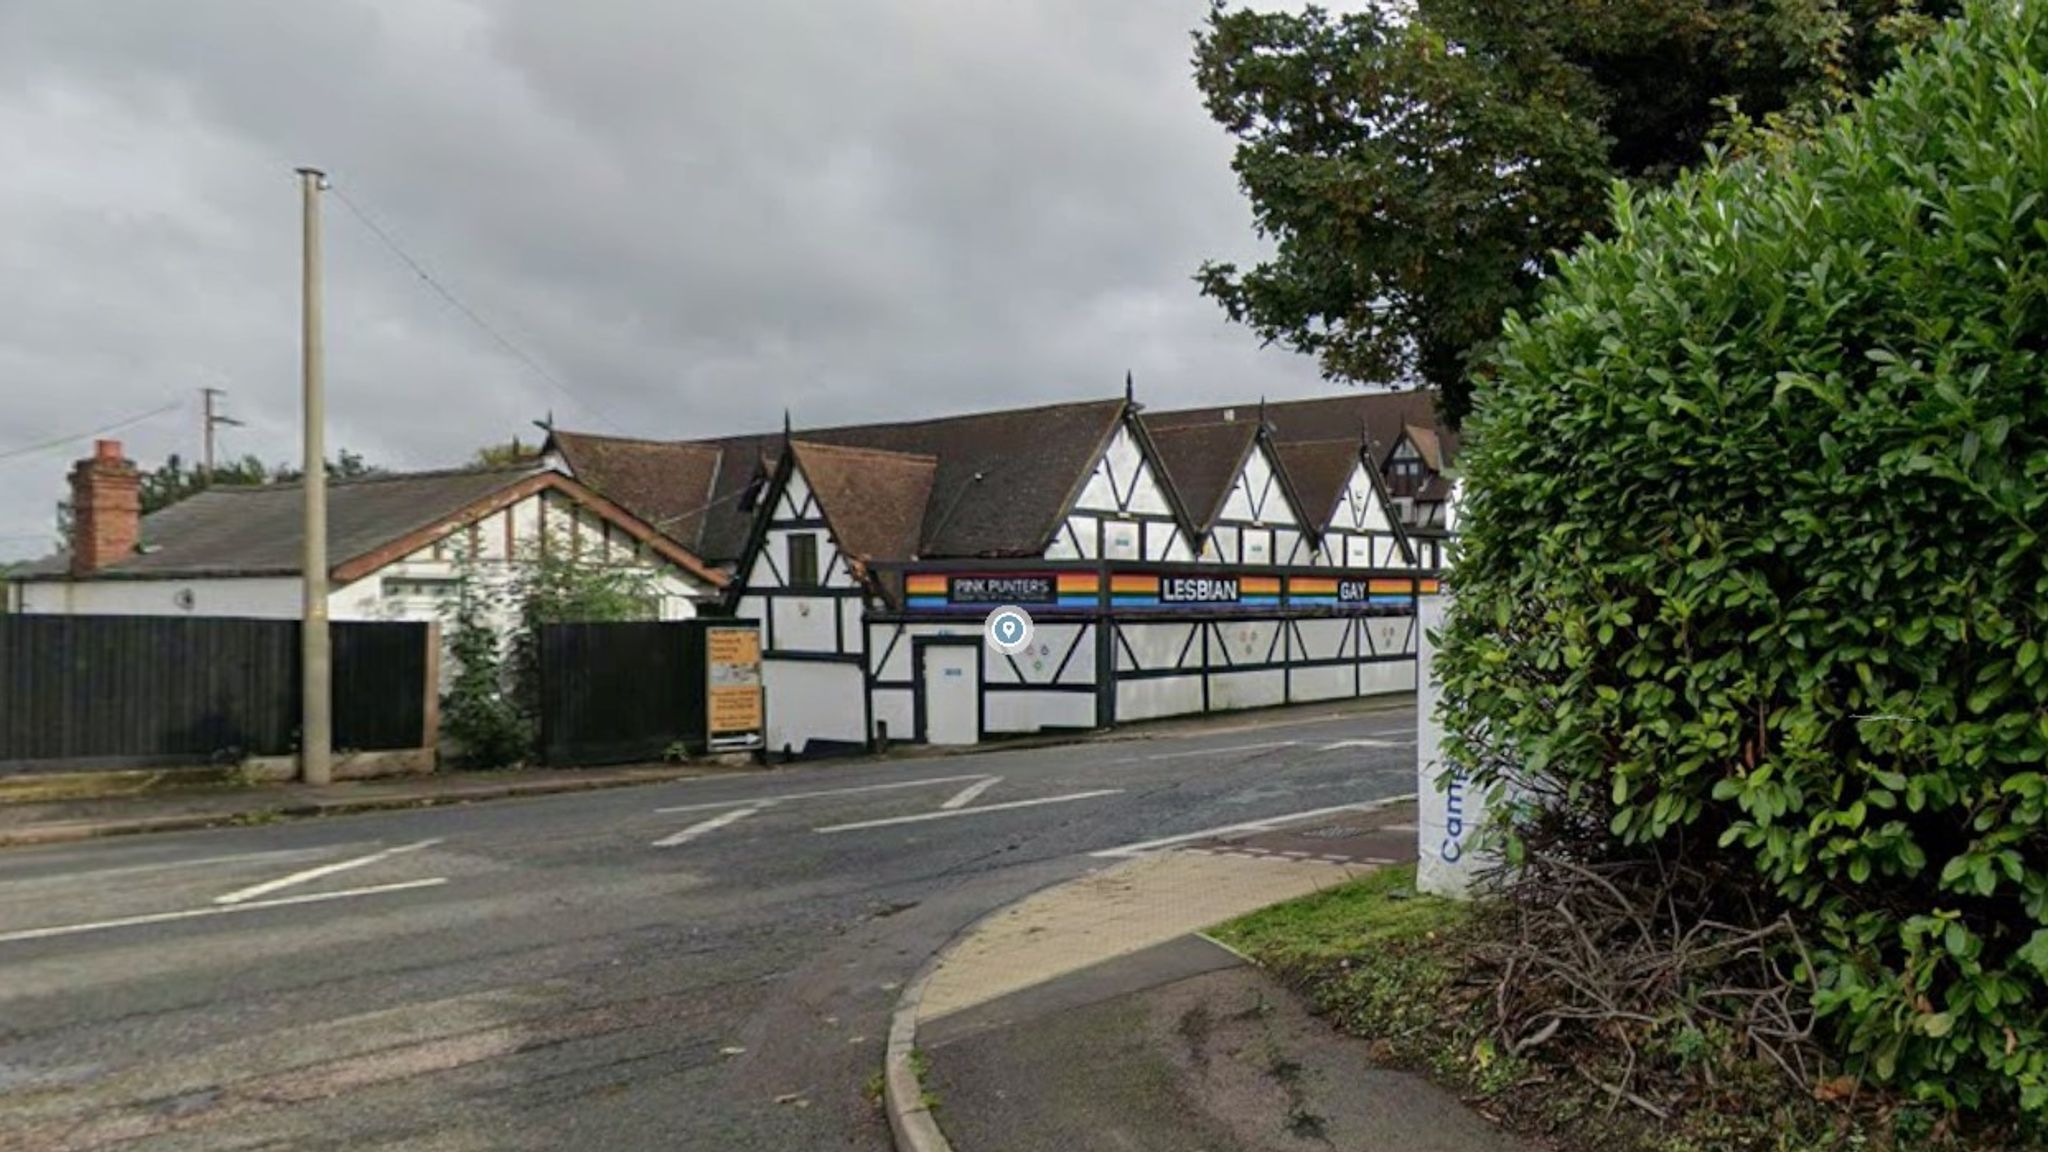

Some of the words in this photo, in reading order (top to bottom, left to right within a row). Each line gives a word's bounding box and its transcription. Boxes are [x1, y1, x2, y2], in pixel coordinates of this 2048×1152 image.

[954, 579, 985, 593] PINK
[1162, 578, 1239, 601] LESBIAN
[1340, 581, 1369, 600] GAY
